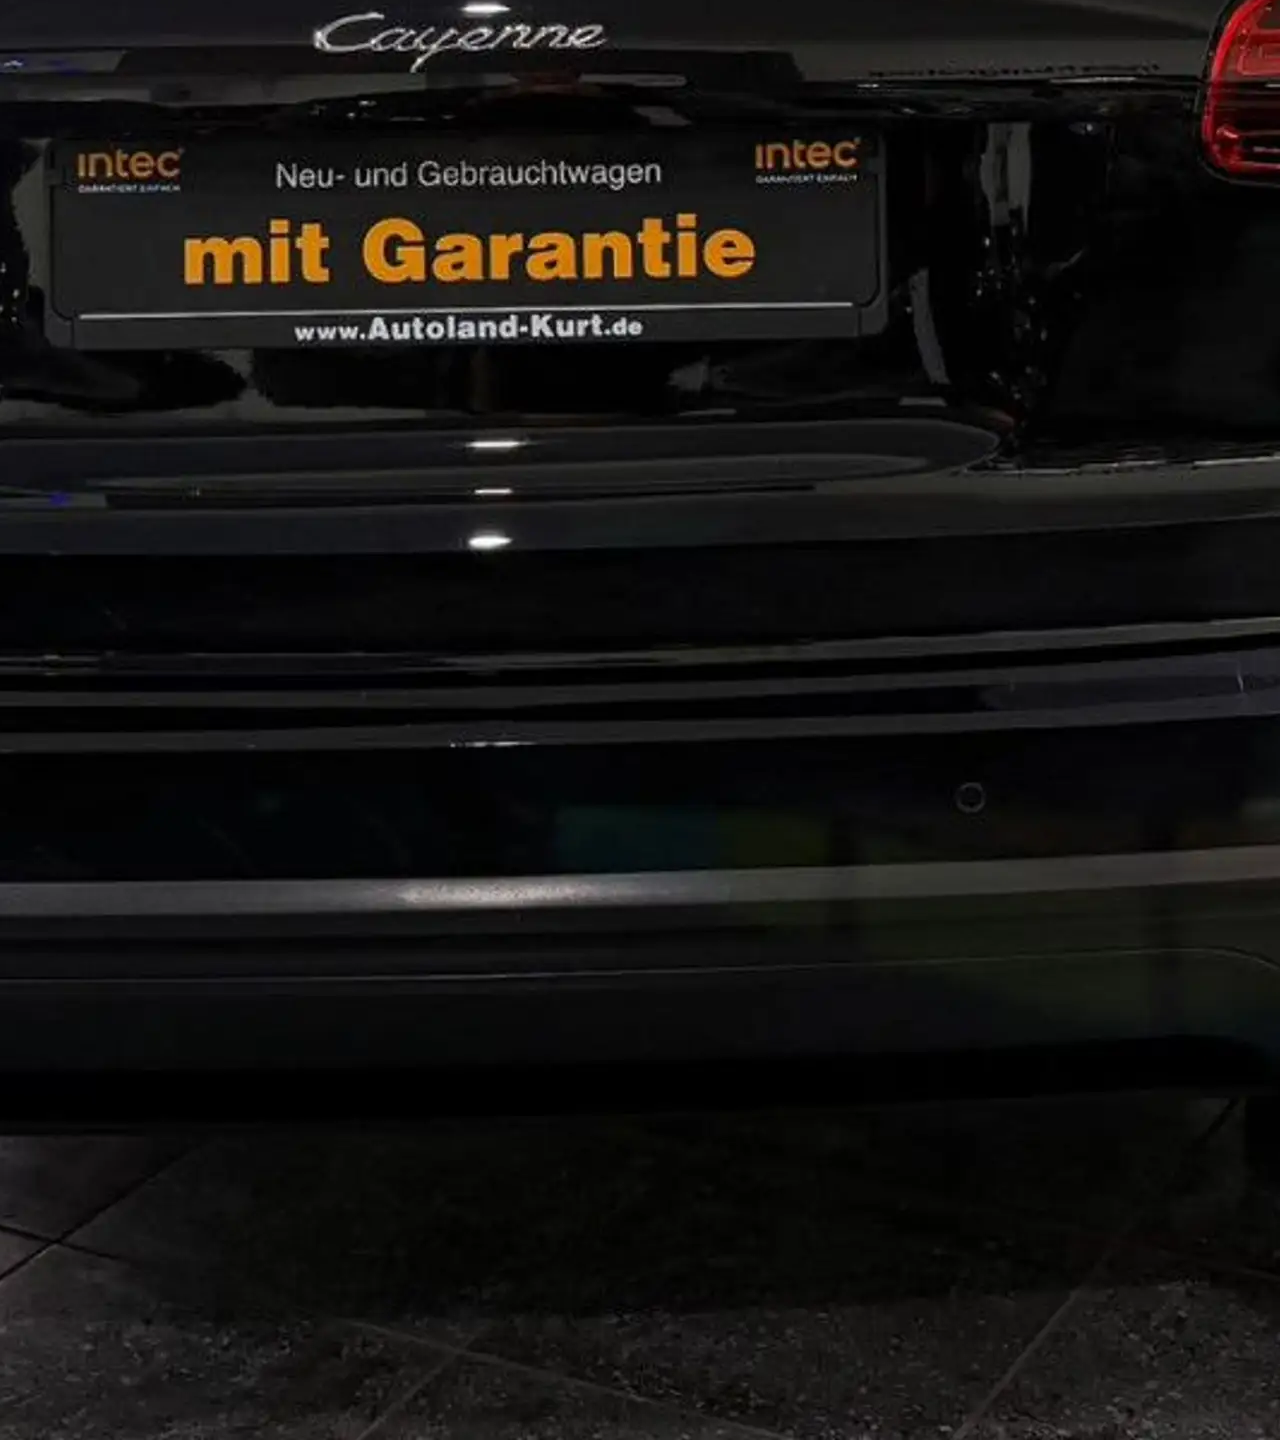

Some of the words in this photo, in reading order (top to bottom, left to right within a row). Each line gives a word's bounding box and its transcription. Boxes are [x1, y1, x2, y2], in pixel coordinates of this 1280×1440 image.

[313, 12, 607, 73] Cayenne
[77, 148, 181, 178] intec
[754, 139, 859, 169] intec
[275, 162, 345, 189] Neu-
[354, 161, 408, 188] und
[417, 159, 662, 191] Gebrauchtwagen
[183, 218, 330, 285] mit
[362, 213, 756, 284] Garantie
[294, 313, 644, 343] www.Autoland-Kurt.de
